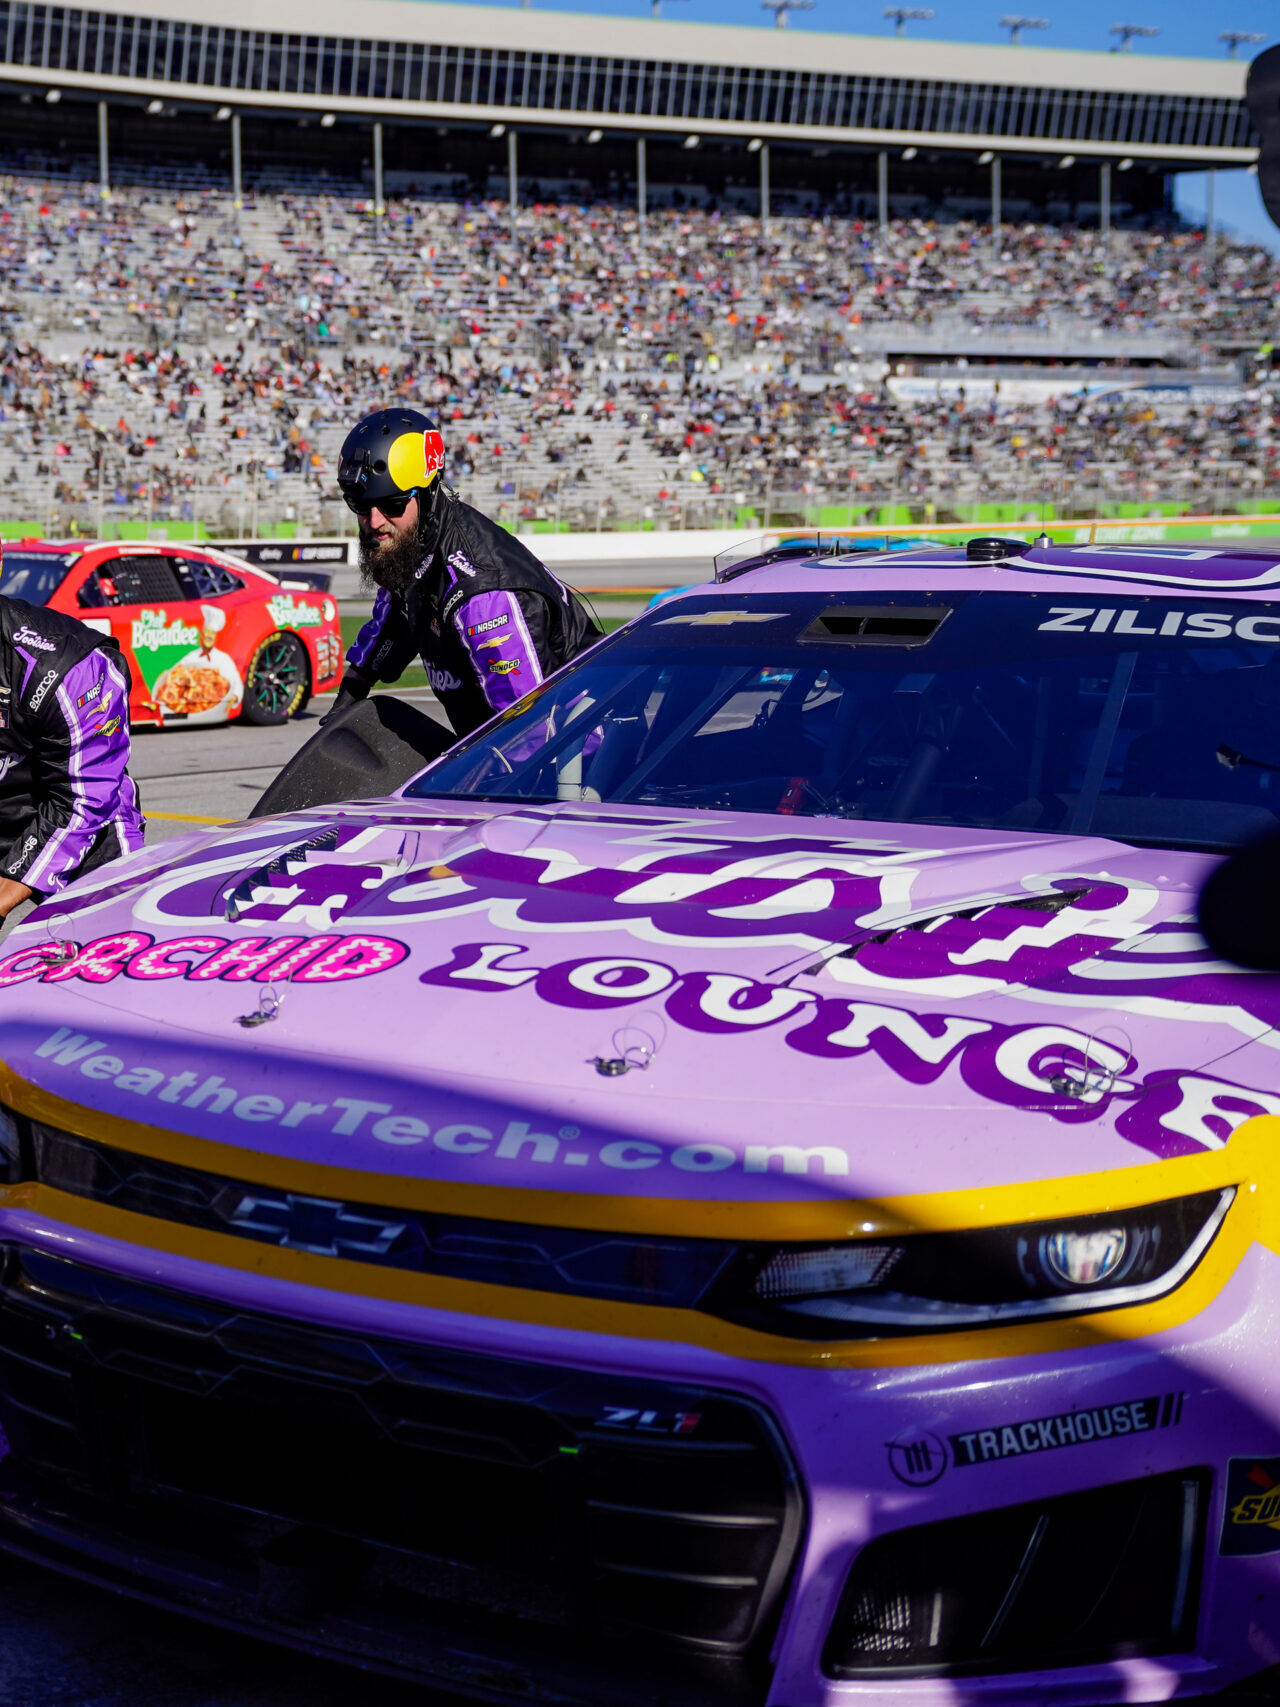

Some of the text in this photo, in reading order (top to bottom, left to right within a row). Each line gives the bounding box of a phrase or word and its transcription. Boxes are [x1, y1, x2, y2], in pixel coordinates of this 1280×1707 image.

[13, 626, 57, 652] Tootsies
[477, 614, 509, 635] NASCAR
[490, 659, 520, 673] SUNOCO
[29, 670, 59, 712] sparco
[420, 942, 1280, 1160] LOUNGE
[958, 1402, 1150, 1463] TRACKHOUSE
